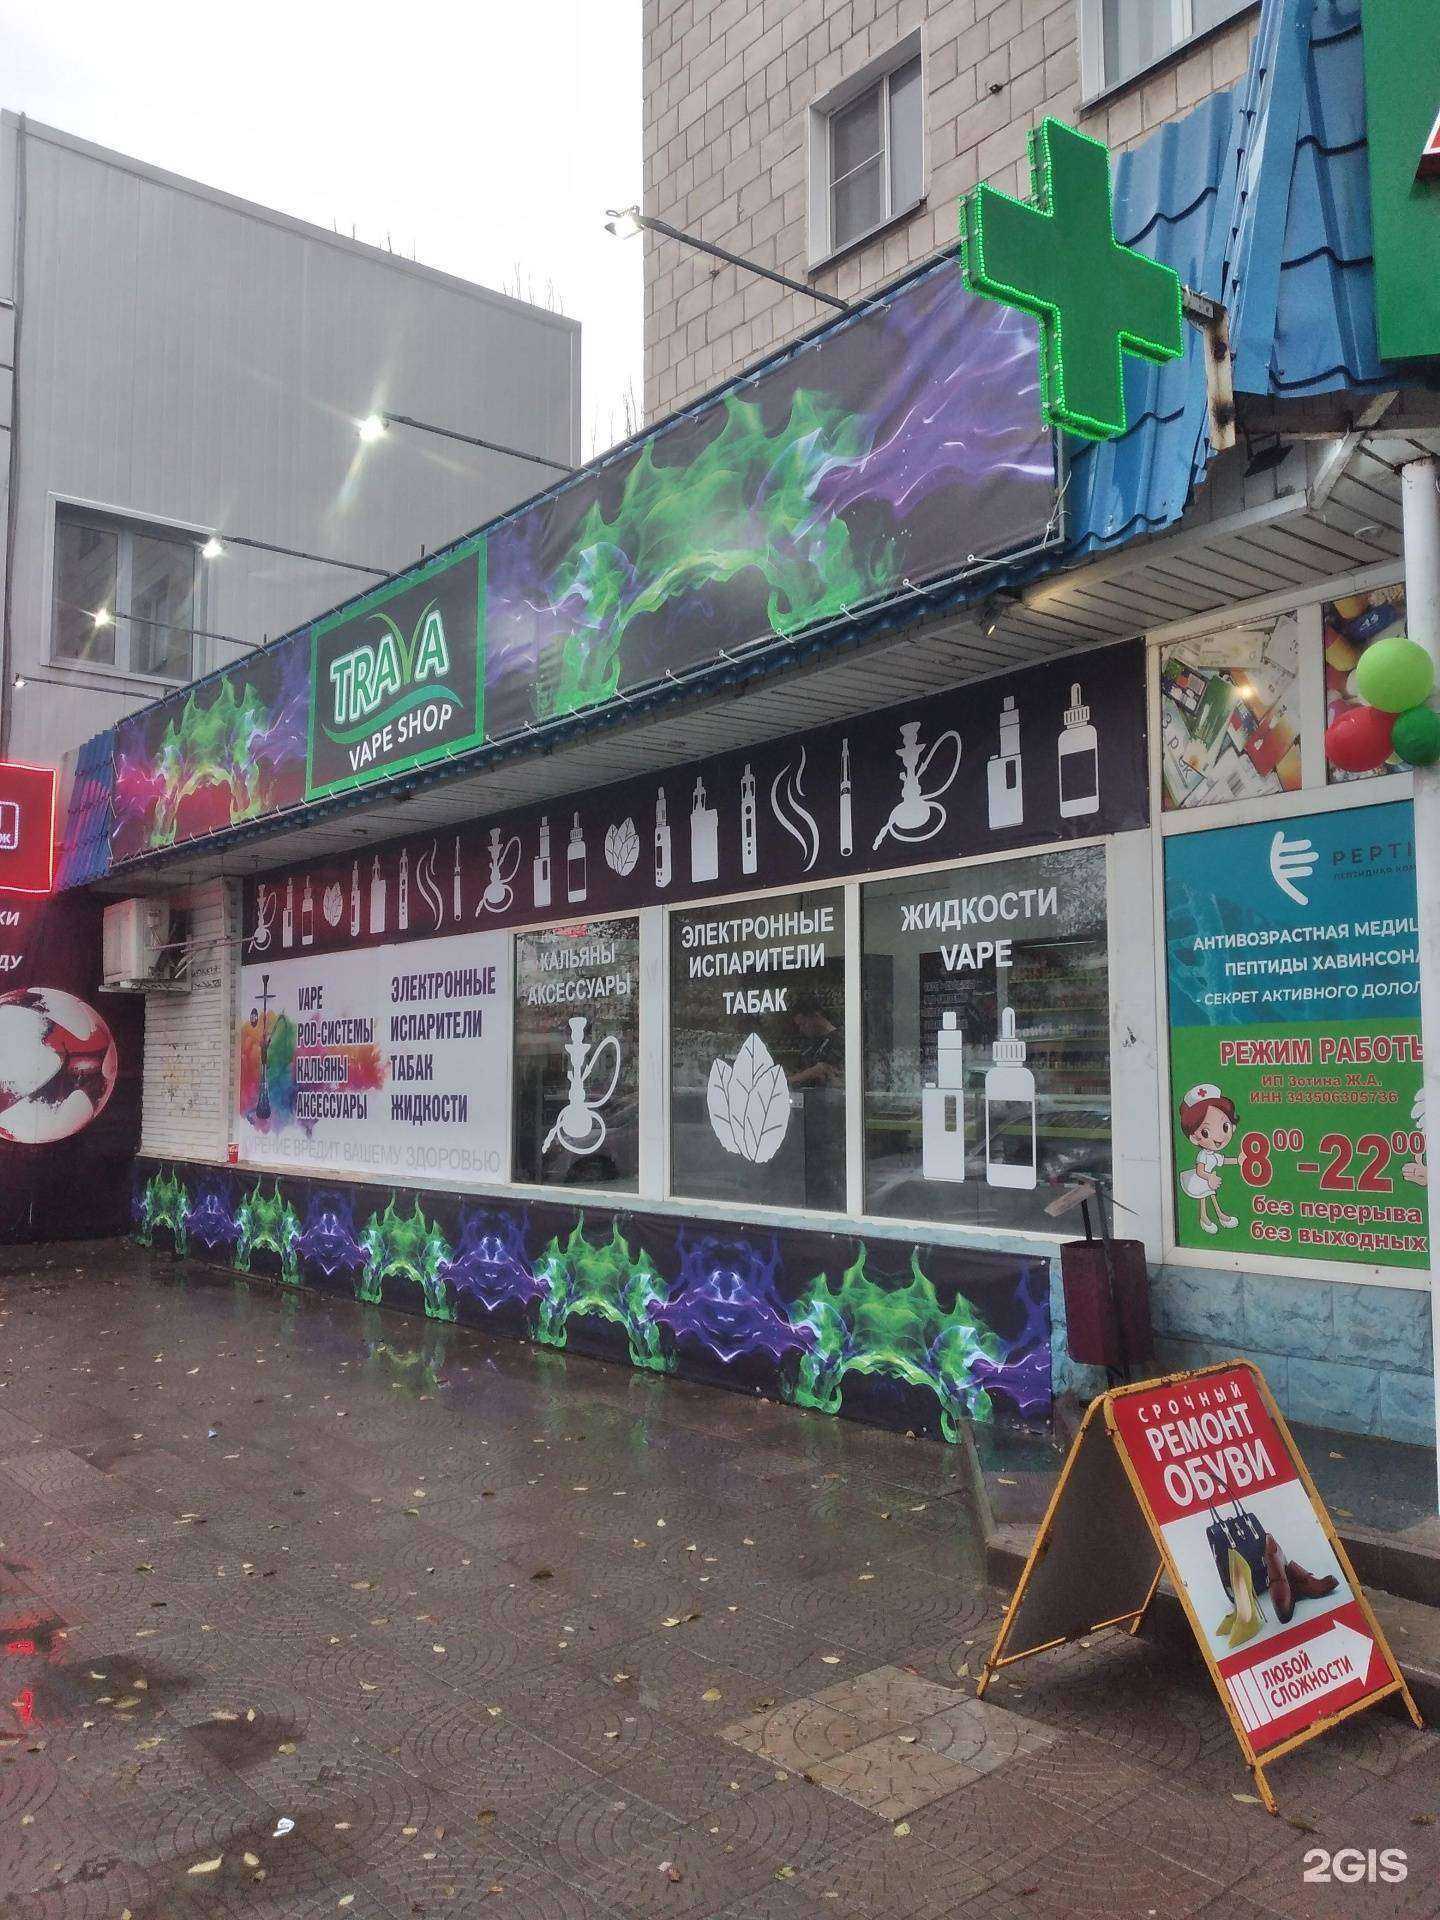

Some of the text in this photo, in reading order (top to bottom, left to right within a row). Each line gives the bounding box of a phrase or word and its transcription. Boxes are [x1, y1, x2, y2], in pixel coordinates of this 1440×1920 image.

[330, 598, 450, 724] TRAVA
[349, 703, 453, 772] VAPE SHOP
[901, 886, 1058, 932] ЖИДКОСТИ
[681, 907, 834, 948] ЭЛЕКТРОННЫЕ
[1193, 923, 1350, 952] АНТИВОЗРАСТНАЯ
[540, 942, 615, 972] КАЛЬЯНЫ
[688, 942, 826, 979] ИСПАРИТЕЛИ
[940, 939, 1013, 971] VAPE
[1225, 956, 1308, 977] ПЕПТИДЫ
[298, 985, 323, 1011] VAPE
[391, 966, 496, 1002] ЭЛЕКТРОННЫЕ
[527, 972, 631, 1006] АКСЕССУАРЫ
[1204, 990, 1259, 1006] СЕКРЕТ
[1262, 984, 1358, 1004] АКТИВНОГО
[722, 987, 788, 1015] ТАБАК
[390, 1010, 482, 1042] ИСПАРИТЕЛИ
[390, 1054, 434, 1081] ТАБАК
[1220, 1038, 1312, 1066] РЕЖИМ
[296, 1056, 349, 1083] КАЛЬЯНЫ
[1261, 1074, 1283, 1087] ИП
[296, 1092, 368, 1120] АКСЕССУАРЫ
[391, 1094, 468, 1126] ЖИДКОСТИ
[1250, 1091, 1282, 1104] ИНН
[293, 1139, 341, 1162] ВРЕДИТ
[344, 1143, 401, 1167] ВАШЕМУ
[405, 1147, 501, 1174] ЗДОРОВЬЮ
[1252, 1195, 1423, 1225] без перерыва
[1250, 1220, 1429, 1252] без выходных
[1138, 1381, 1242, 1423] СРОЧНЫЙ
[1145, 1403, 1254, 1462] РЕМОНТ
[1163, 1438, 1277, 1507] ОБУВИ
[1261, 1649, 1313, 1689] ЛЮБОЙ
[1269, 1655, 1354, 1708] СЛОЖНОСТИ
